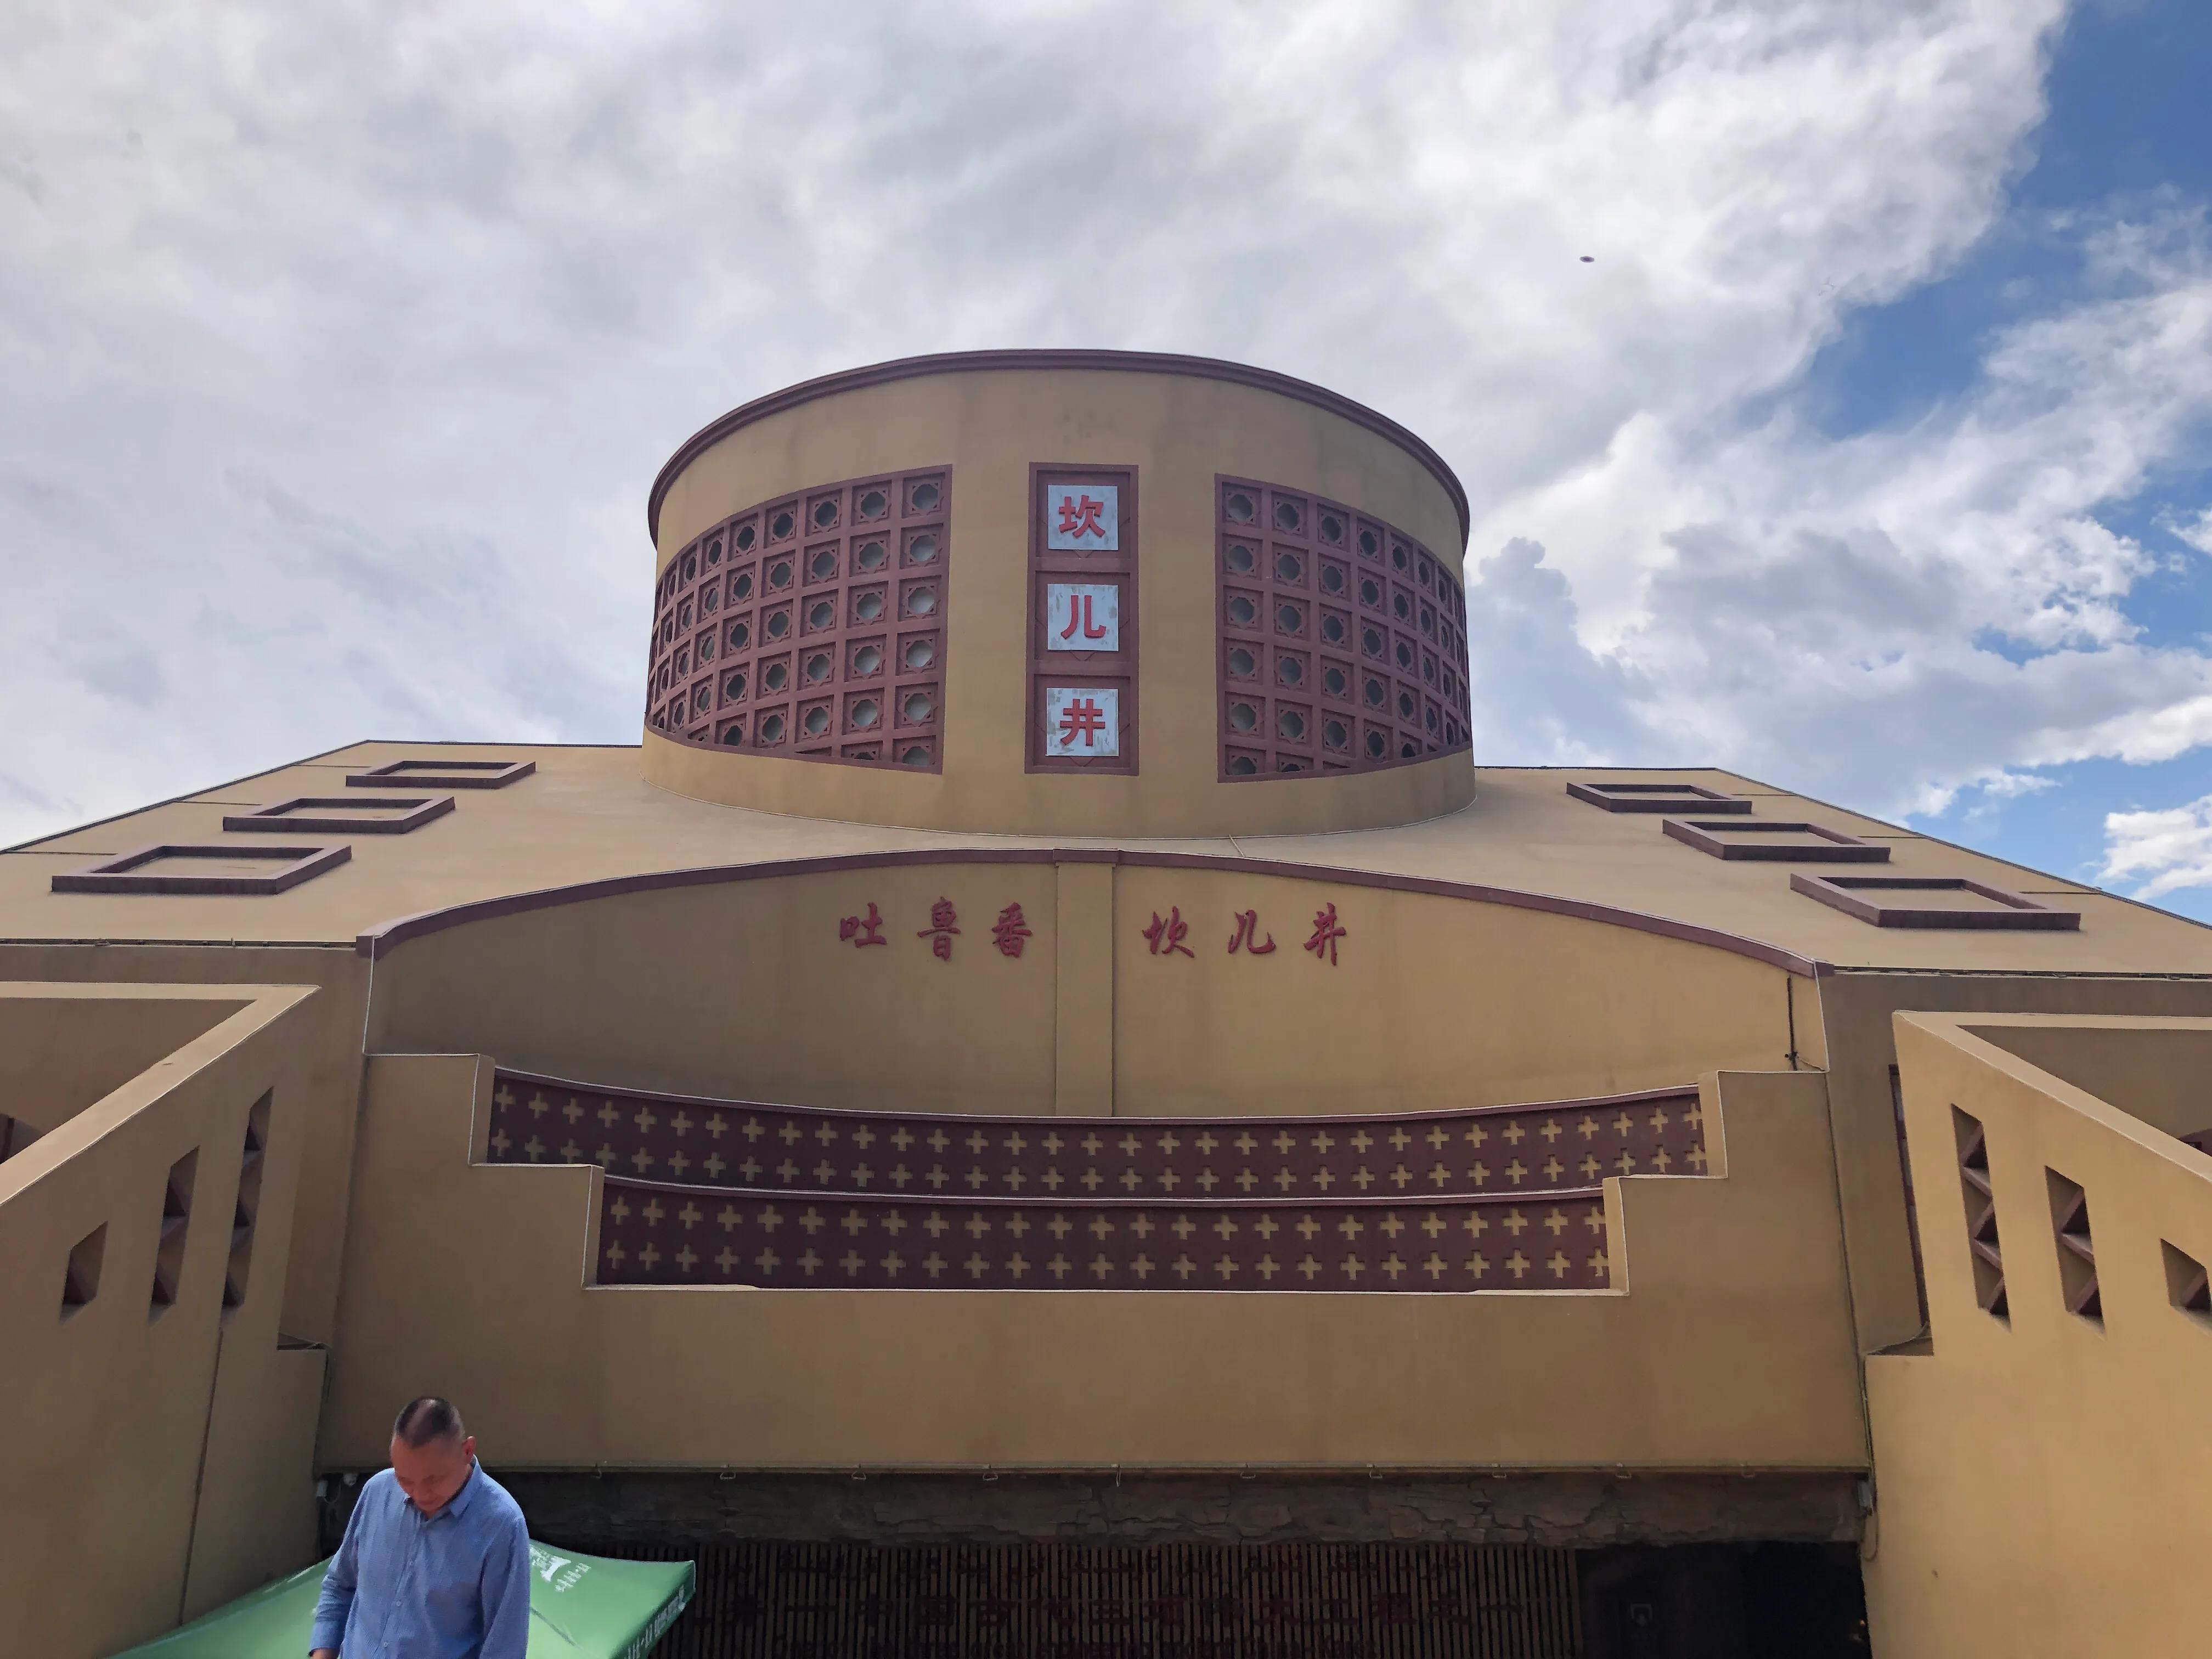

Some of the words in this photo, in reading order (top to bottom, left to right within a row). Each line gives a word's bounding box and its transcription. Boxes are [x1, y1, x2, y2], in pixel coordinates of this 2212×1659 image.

[1059, 495, 1106, 747] 坎儿井
[839, 896, 1032, 960] 吐鲁番
[1142, 901, 1346, 966] 坎儿井
